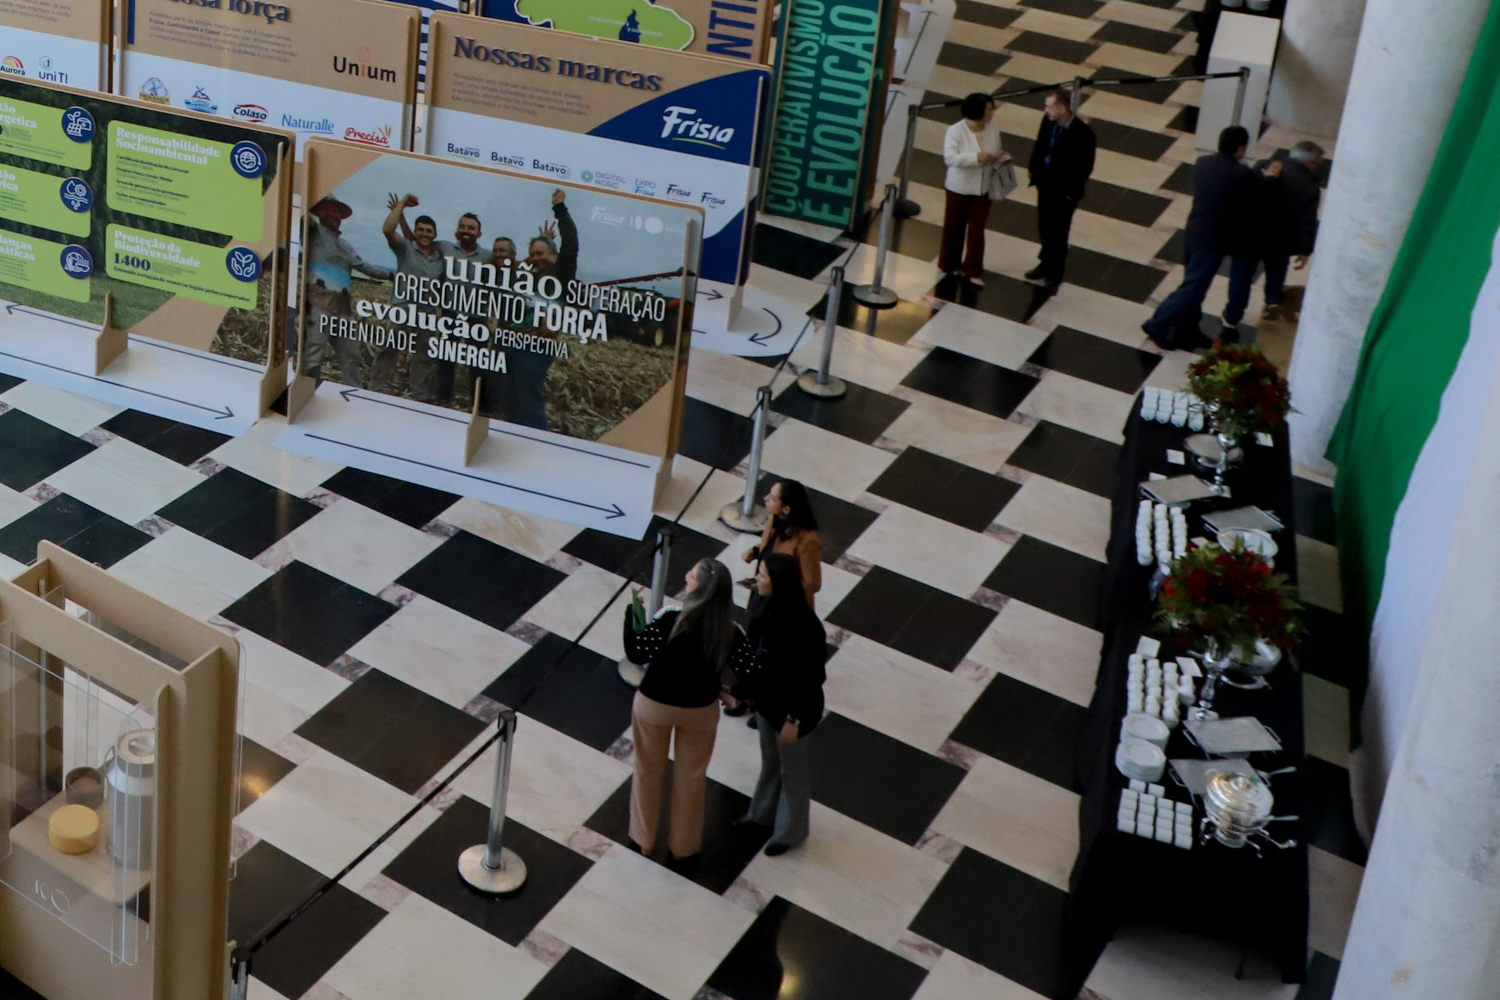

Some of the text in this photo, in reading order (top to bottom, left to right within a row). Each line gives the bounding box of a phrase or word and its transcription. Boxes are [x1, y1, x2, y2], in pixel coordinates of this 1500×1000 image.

[0, 65, 26, 76] Aurora
[333, 56, 396, 83] Unium
[453, 36, 662, 92] Nossas marcas
[806, 4, 878, 195] EVOLUÇÃO
[233, 106, 268, 121] Colaso
[281, 114, 335, 132] Naturalle
[116, 126, 221, 158] Responsabilidade
[344, 126, 389, 145] Precisa
[116, 137, 208, 166] Socioambiental
[447, 142, 480, 159] Batavo
[490, 151, 524, 167] Batavo
[532, 159, 566, 175] Batavo
[114, 230, 182, 254] Proteção da
[114, 239, 201, 268] Biodiversidade
[114, 253, 151, 271] 1400
[444, 255, 666, 323] união SUPERAÇÃO
[394, 271, 609, 344] CRESCIMENTO FORÇA
[355, 298, 569, 360] evolução PERSPECTIVA
[319, 314, 507, 374] PERENIDADE SINERGIA
